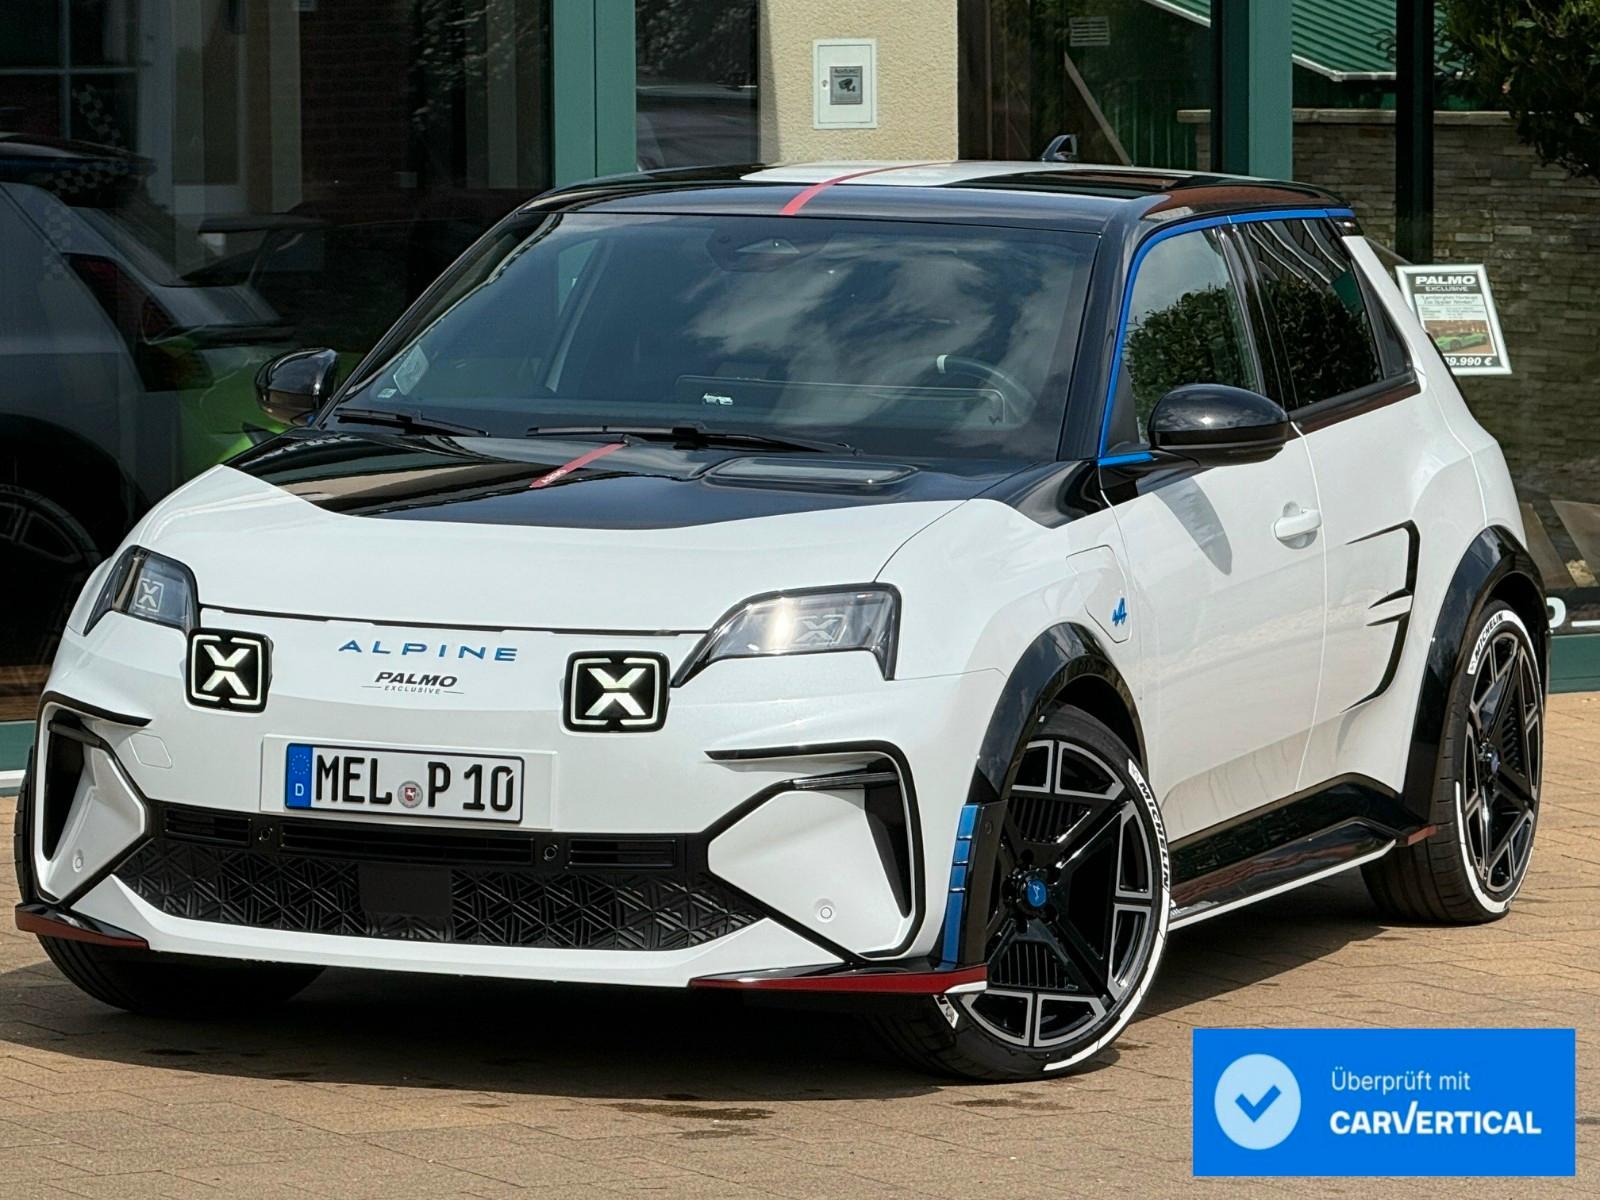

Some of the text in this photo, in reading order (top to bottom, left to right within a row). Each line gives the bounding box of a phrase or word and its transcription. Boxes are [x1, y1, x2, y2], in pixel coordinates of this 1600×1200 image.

[1415, 276, 1476, 285] PALMO
[1484, 357, 1493, 366] €
[1475, 612, 1504, 660] MICHELIN
[338, 639, 518, 662] ALPINE
[375, 672, 458, 688] PALMO
[384, 685, 441, 695] EXCLUSIVE
[295, 783, 305, 797] D
[315, 754, 515, 812] MEL P 10
[1139, 781, 1170, 889] MICHELIN
